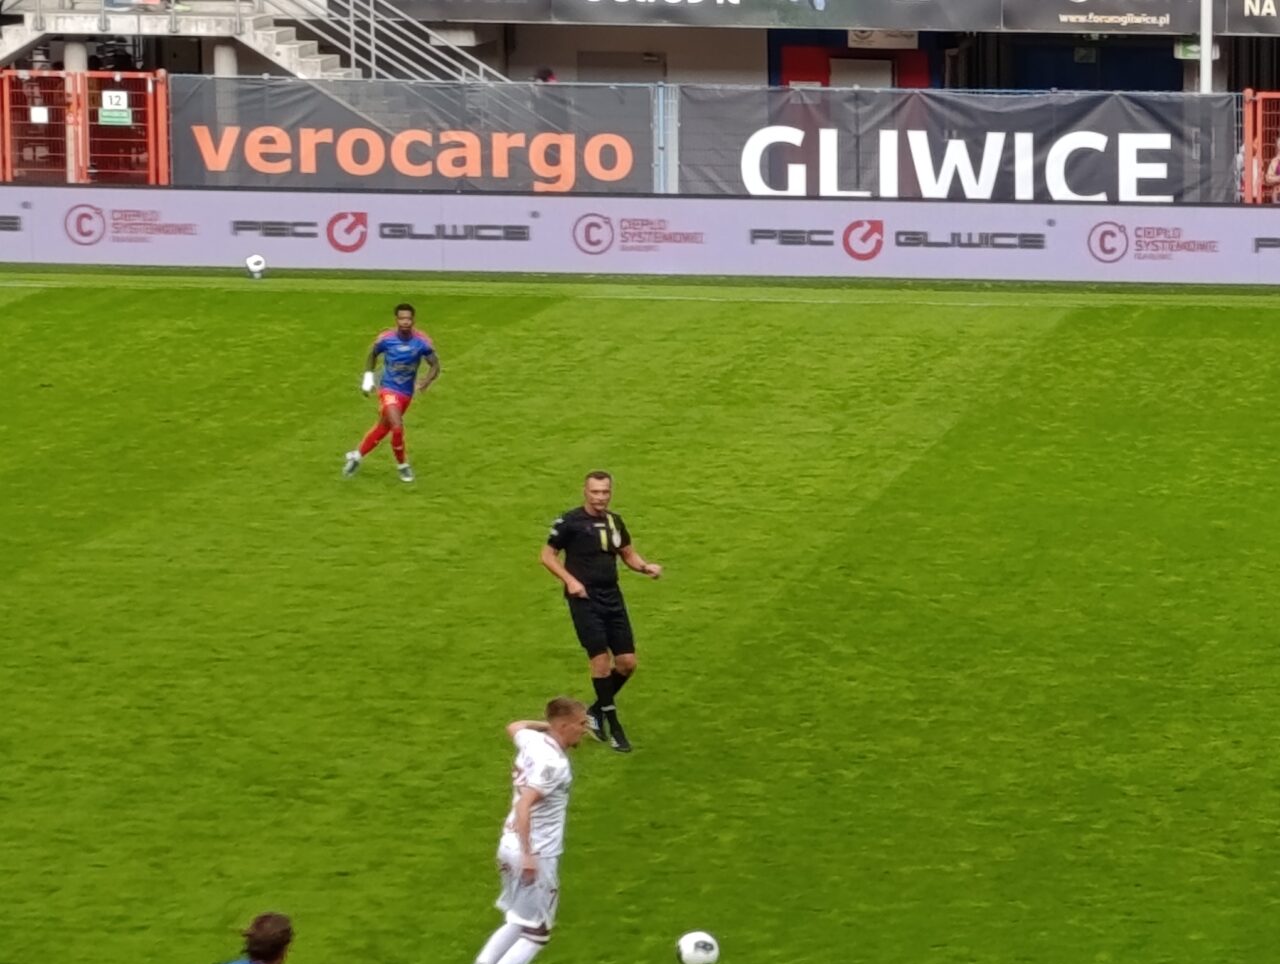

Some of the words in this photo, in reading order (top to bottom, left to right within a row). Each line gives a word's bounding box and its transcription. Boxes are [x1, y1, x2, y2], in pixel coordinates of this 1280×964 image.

[1244, 0, 1277, 17] NA
[108, 94, 122, 106] 12
[190, 123, 635, 193] verocargo
[739, 125, 1175, 203] GLIWICE
